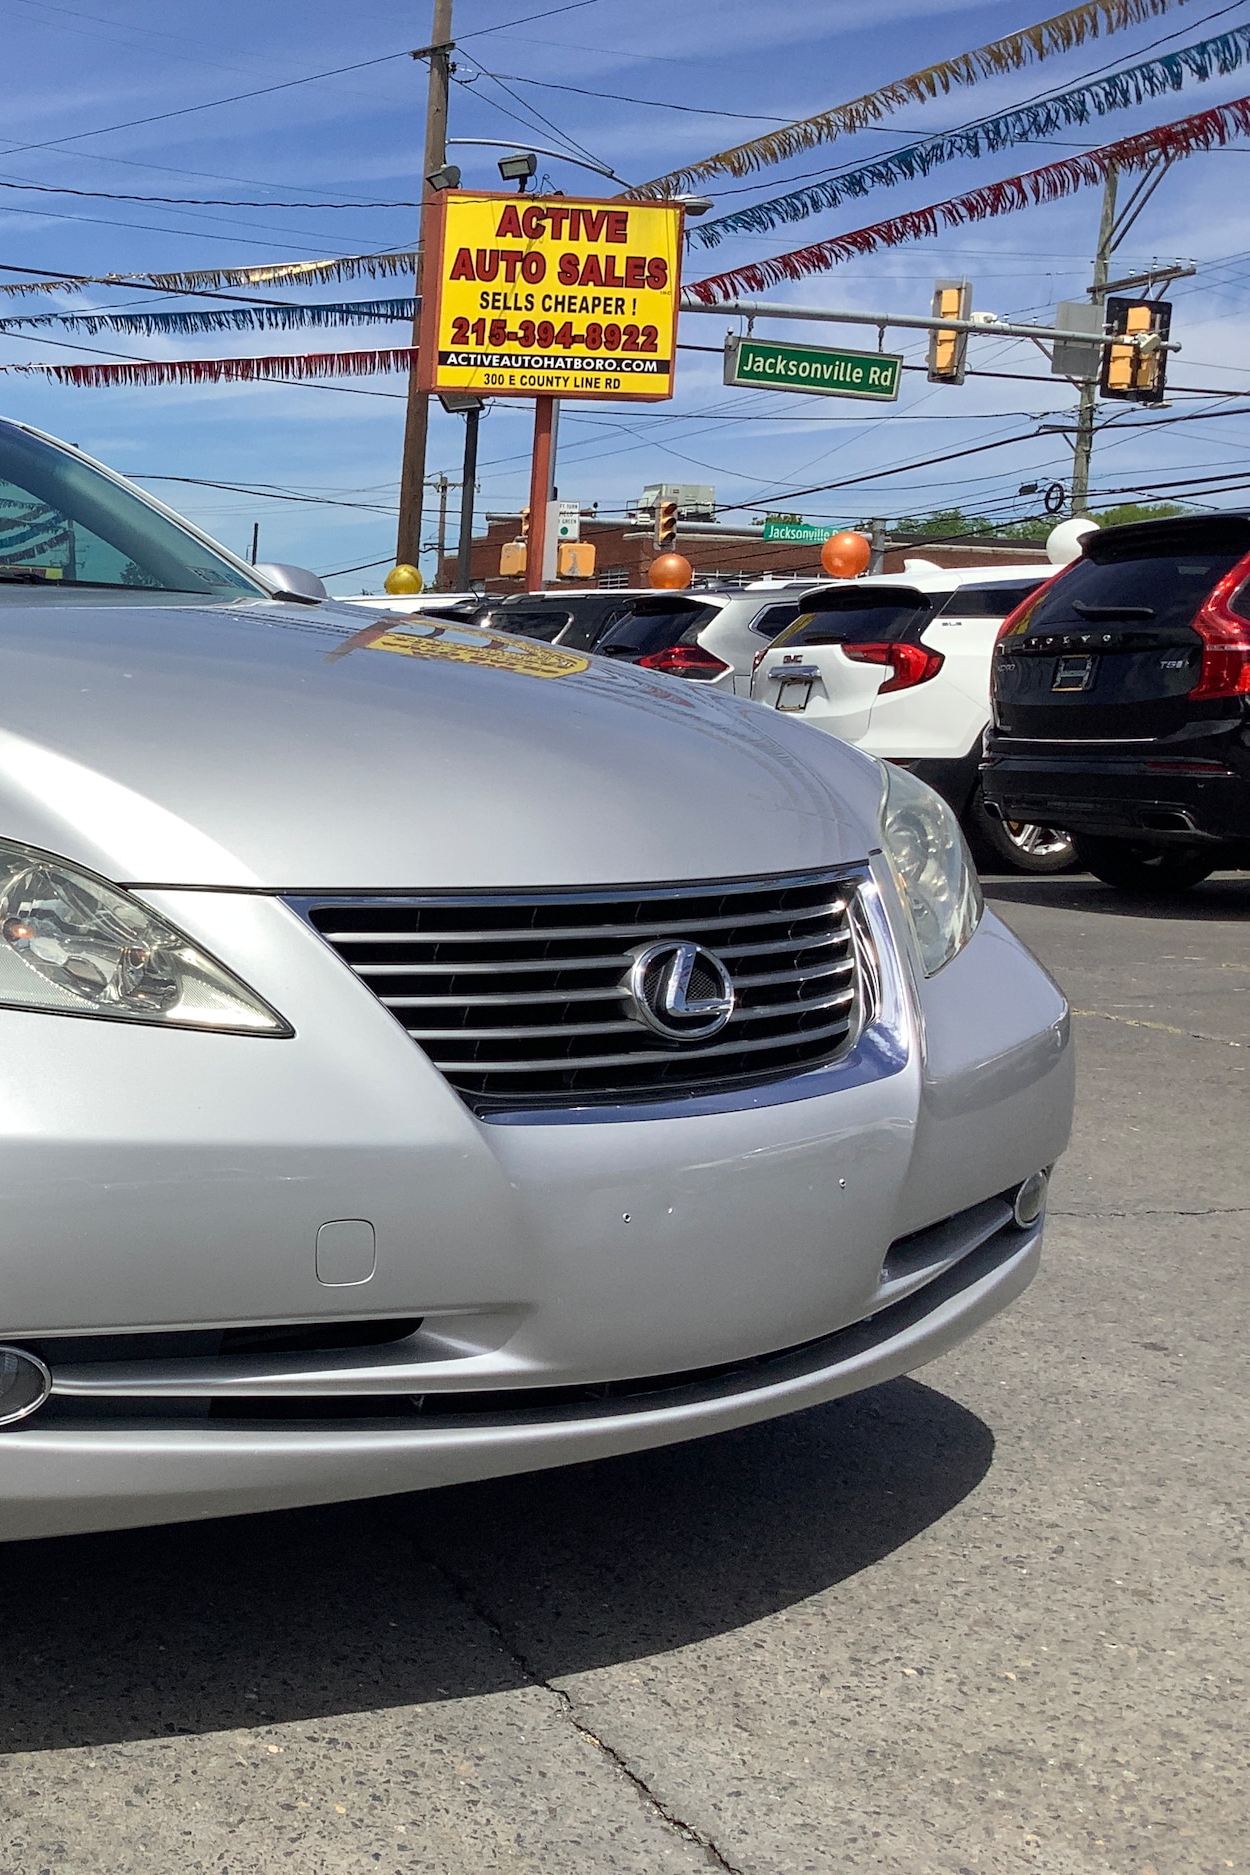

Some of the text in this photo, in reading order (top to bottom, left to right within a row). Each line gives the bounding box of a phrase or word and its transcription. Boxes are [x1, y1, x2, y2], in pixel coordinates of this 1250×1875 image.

[495, 204, 629, 244] ACTIVE
[449, 247, 668, 290] AUTO SALES
[479, 291, 535, 312] SELLS
[542, 294, 626, 316] CHEAPER
[450, 316, 658, 353] 215-394-8922
[446, 353, 658, 373] ACTIVEAUTOHATBORO.COM
[742, 353, 893, 387] Jacksonville Rd
[483, 373, 621, 390] 300 E COUNTY LINE RD
[768, 525, 830, 542] Jacksonville
[783, 654, 804, 664] GMC
